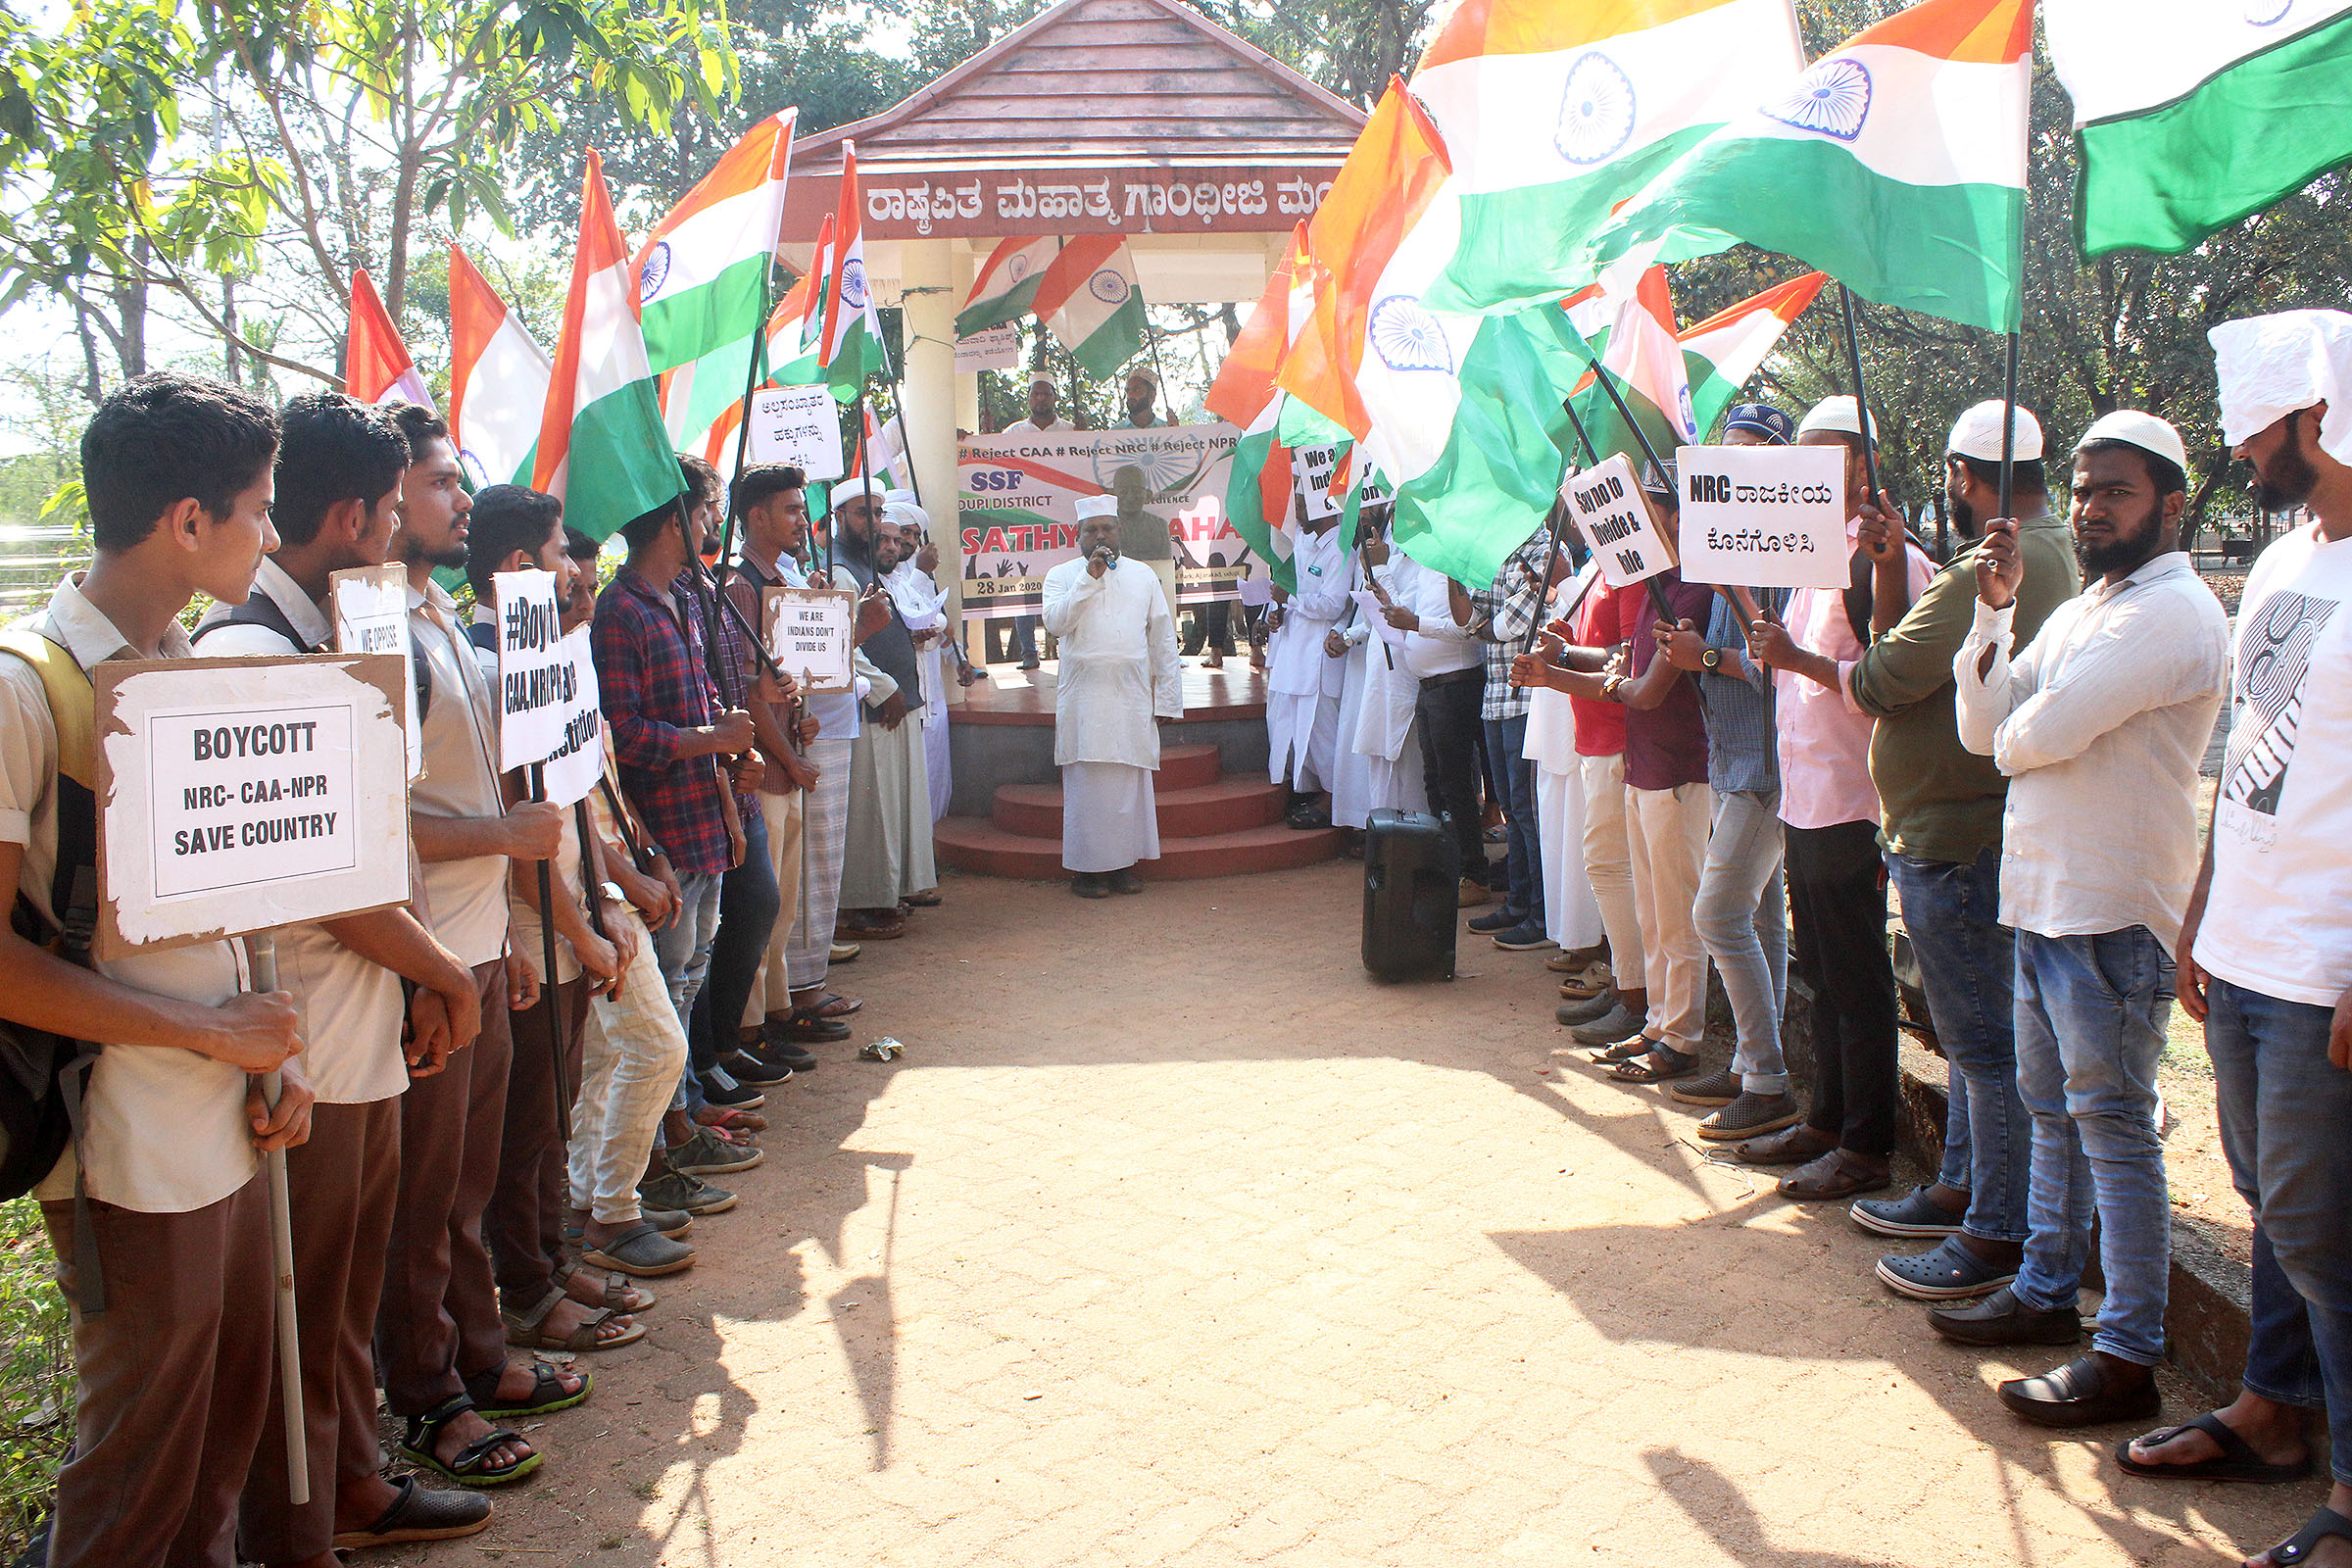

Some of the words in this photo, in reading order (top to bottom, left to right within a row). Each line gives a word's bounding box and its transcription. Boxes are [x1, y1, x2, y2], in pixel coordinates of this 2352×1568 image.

[997, 175, 1121, 225] ಮಹಾತ್ಮ
[971, 448, 1015, 461] Reject
[1020, 447, 1054, 458] CAA
[1069, 445, 1111, 458] Reject
[1115, 443, 1148, 454] NRC
[1163, 440, 1205, 453] Reject
[1208, 437, 1238, 449] NPR
[1304, 450, 1327, 468] We
[971, 470, 1024, 492] SSF
[1605, 476, 1624, 500] to
[1690, 474, 1731, 503] NRC
[1736, 481, 1833, 504] ರಾಜಕೀಯ
[958, 498, 988, 511] DUPI
[993, 496, 1053, 509] DISTRICT
[977, 581, 995, 594] 28
[998, 584, 1016, 593] Jan
[1019, 582, 1043, 591] 2020
[799, 612, 809, 621] WE
[810, 612, 823, 621] ARE
[787, 626, 814, 637] INDIANS
[796, 642, 816, 652] DIVIDE
[817, 642, 827, 652] US
[194, 721, 317, 761] BOYCOTT
[183, 786, 235, 810] NRC-
[241, 774, 328, 805] CAA-NPR
[174, 824, 235, 856] SAVE
[241, 811, 338, 846] COUNTRY
